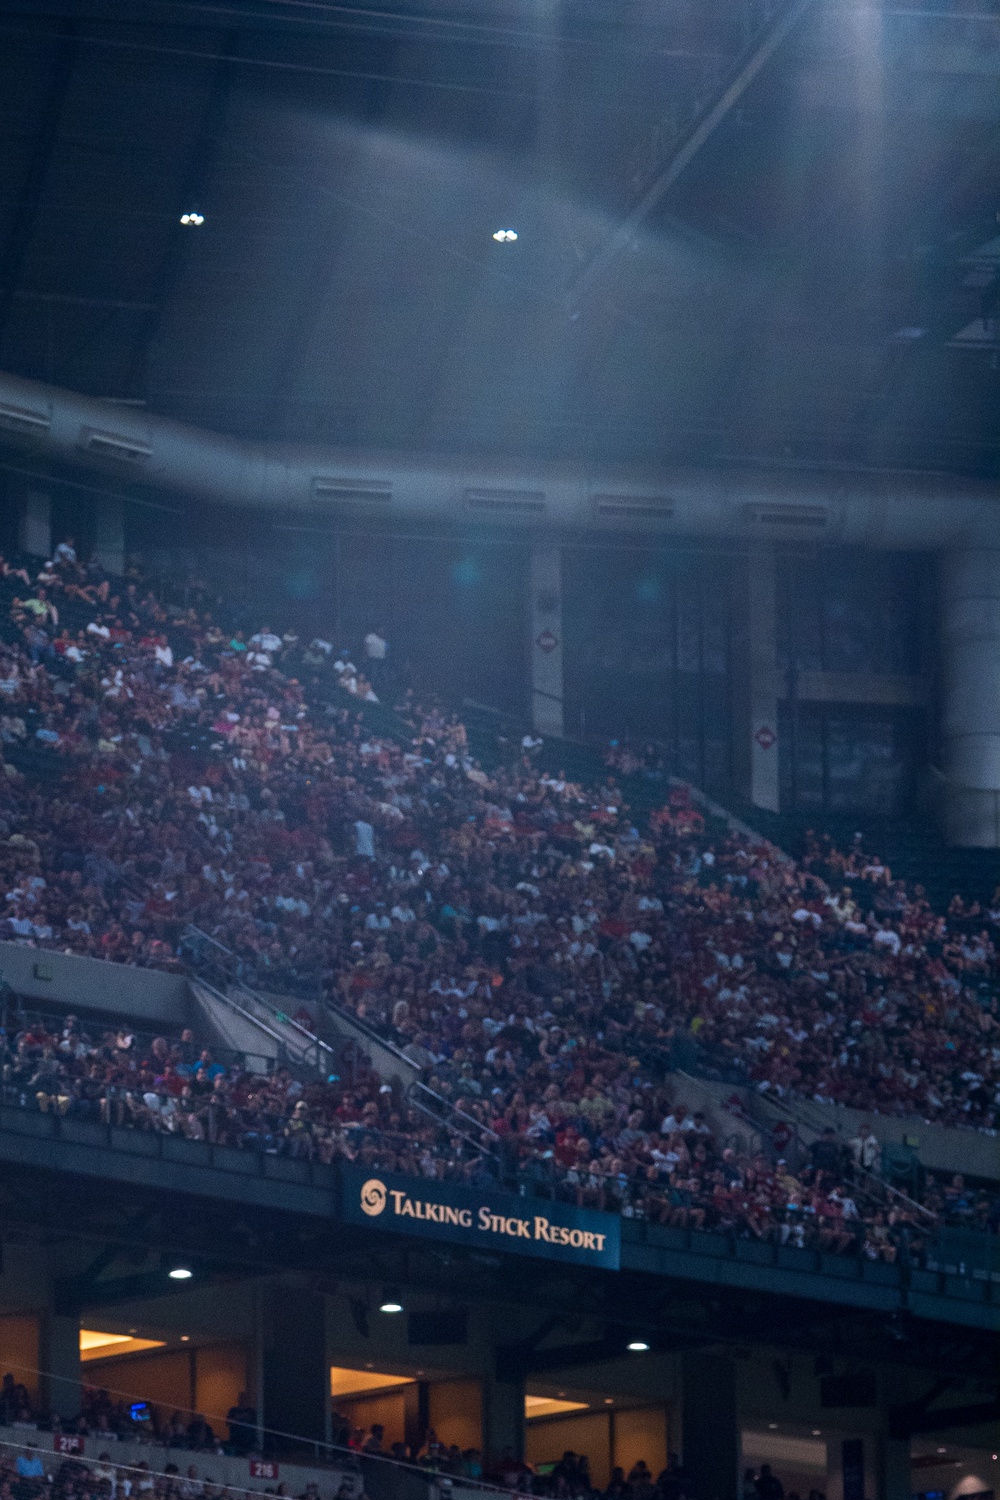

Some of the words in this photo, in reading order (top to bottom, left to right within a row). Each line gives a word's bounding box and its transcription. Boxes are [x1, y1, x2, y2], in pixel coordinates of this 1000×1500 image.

[389, 1189, 472, 1228] TALKING
[477, 1206, 531, 1239] STICK
[533, 1216, 607, 1251] RESORT
